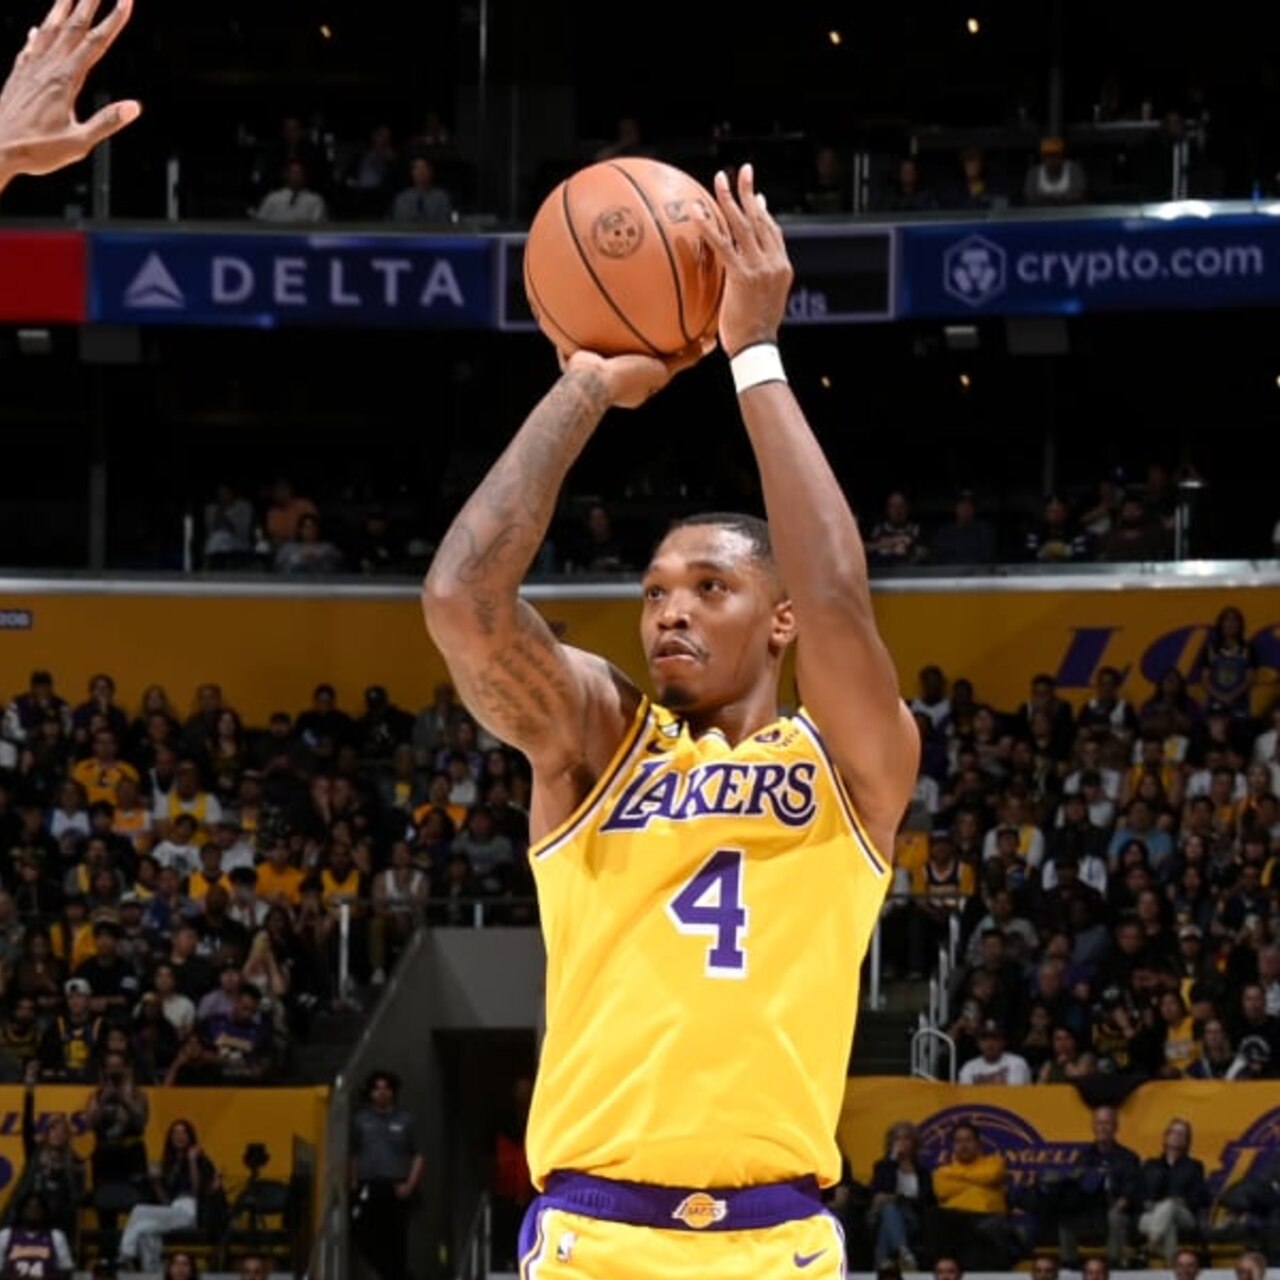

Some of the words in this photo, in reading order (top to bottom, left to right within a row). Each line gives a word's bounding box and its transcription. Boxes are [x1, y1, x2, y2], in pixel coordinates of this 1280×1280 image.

[212, 255, 464, 298] DELTA
[1017, 244, 1264, 287] crypto.com
[598, 757, 818, 834] LAKERS
[666, 846, 749, 980] 4
